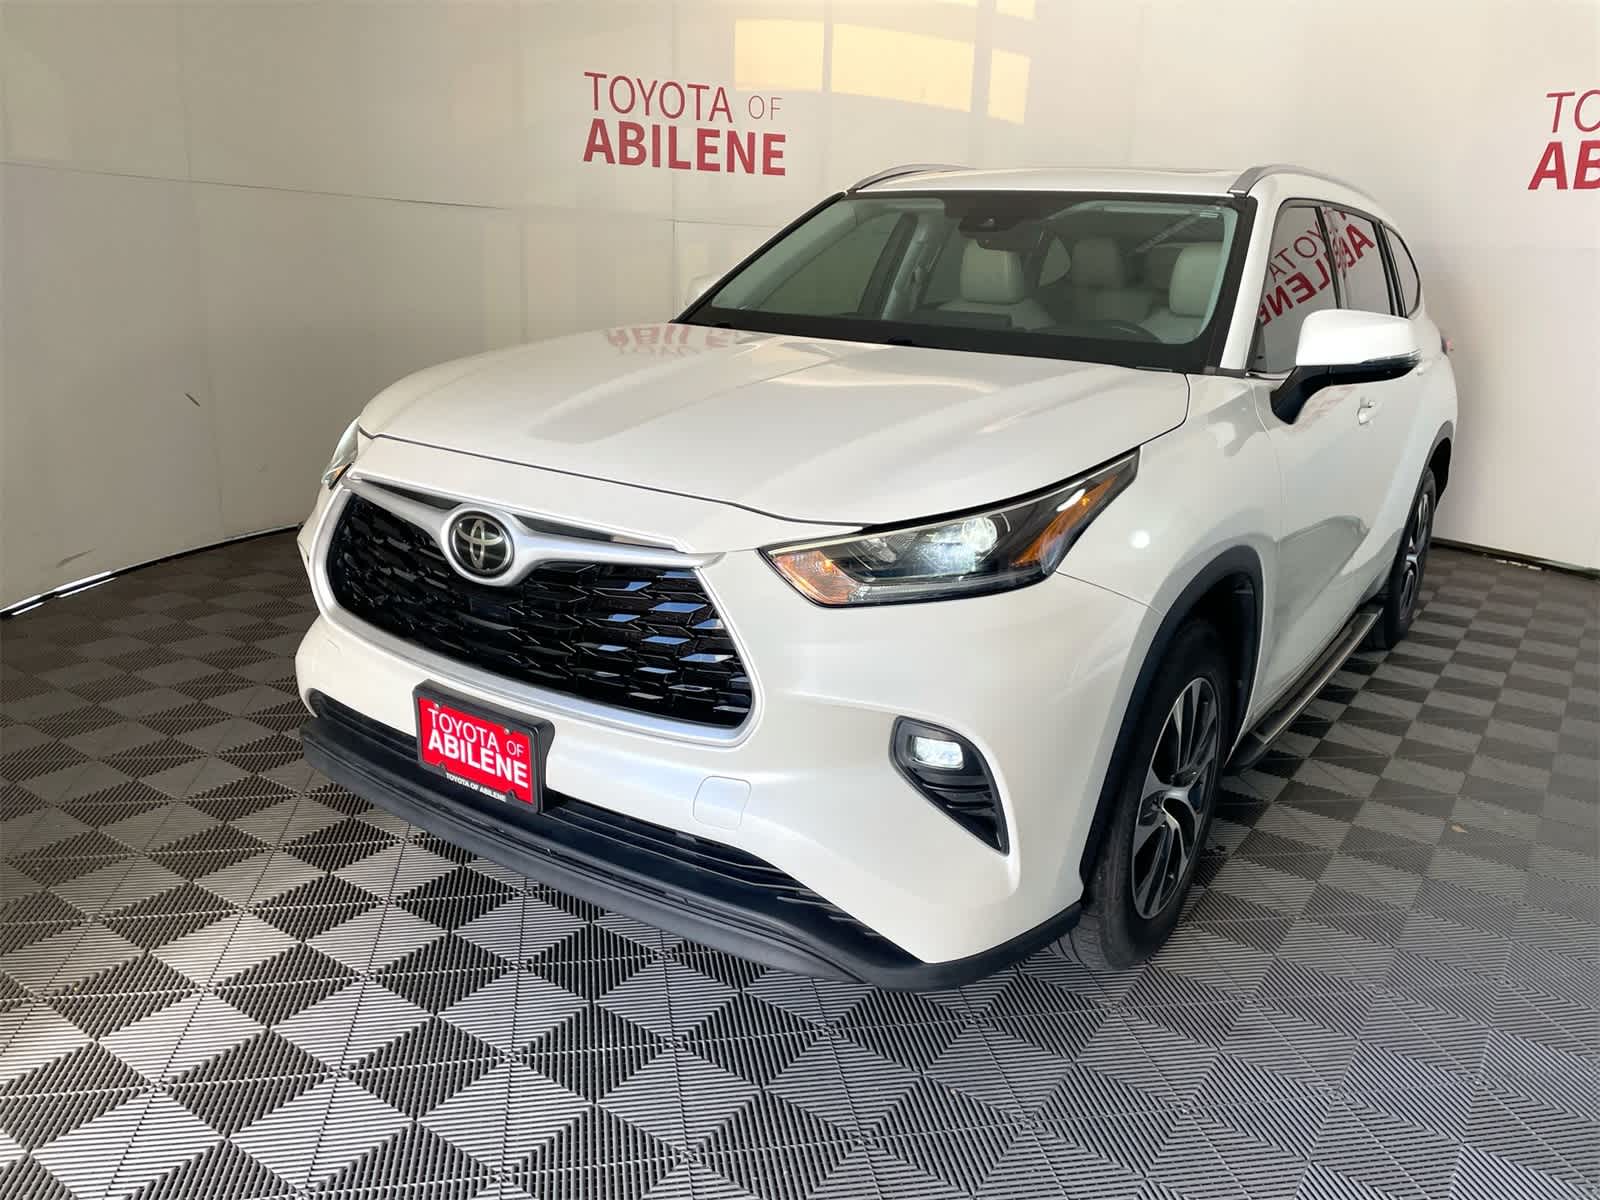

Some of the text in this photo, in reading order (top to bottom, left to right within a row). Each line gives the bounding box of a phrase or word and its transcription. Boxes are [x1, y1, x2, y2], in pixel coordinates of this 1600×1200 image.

[584, 71, 783, 123] TOYOTA OF
[583, 118, 786, 176] ABILENE
[427, 708, 525, 757] TOYOTA OF
[428, 729, 529, 788] ABILENE
[445, 772, 470, 788] TOYOTA
[479, 786, 507, 802] ABILENE
